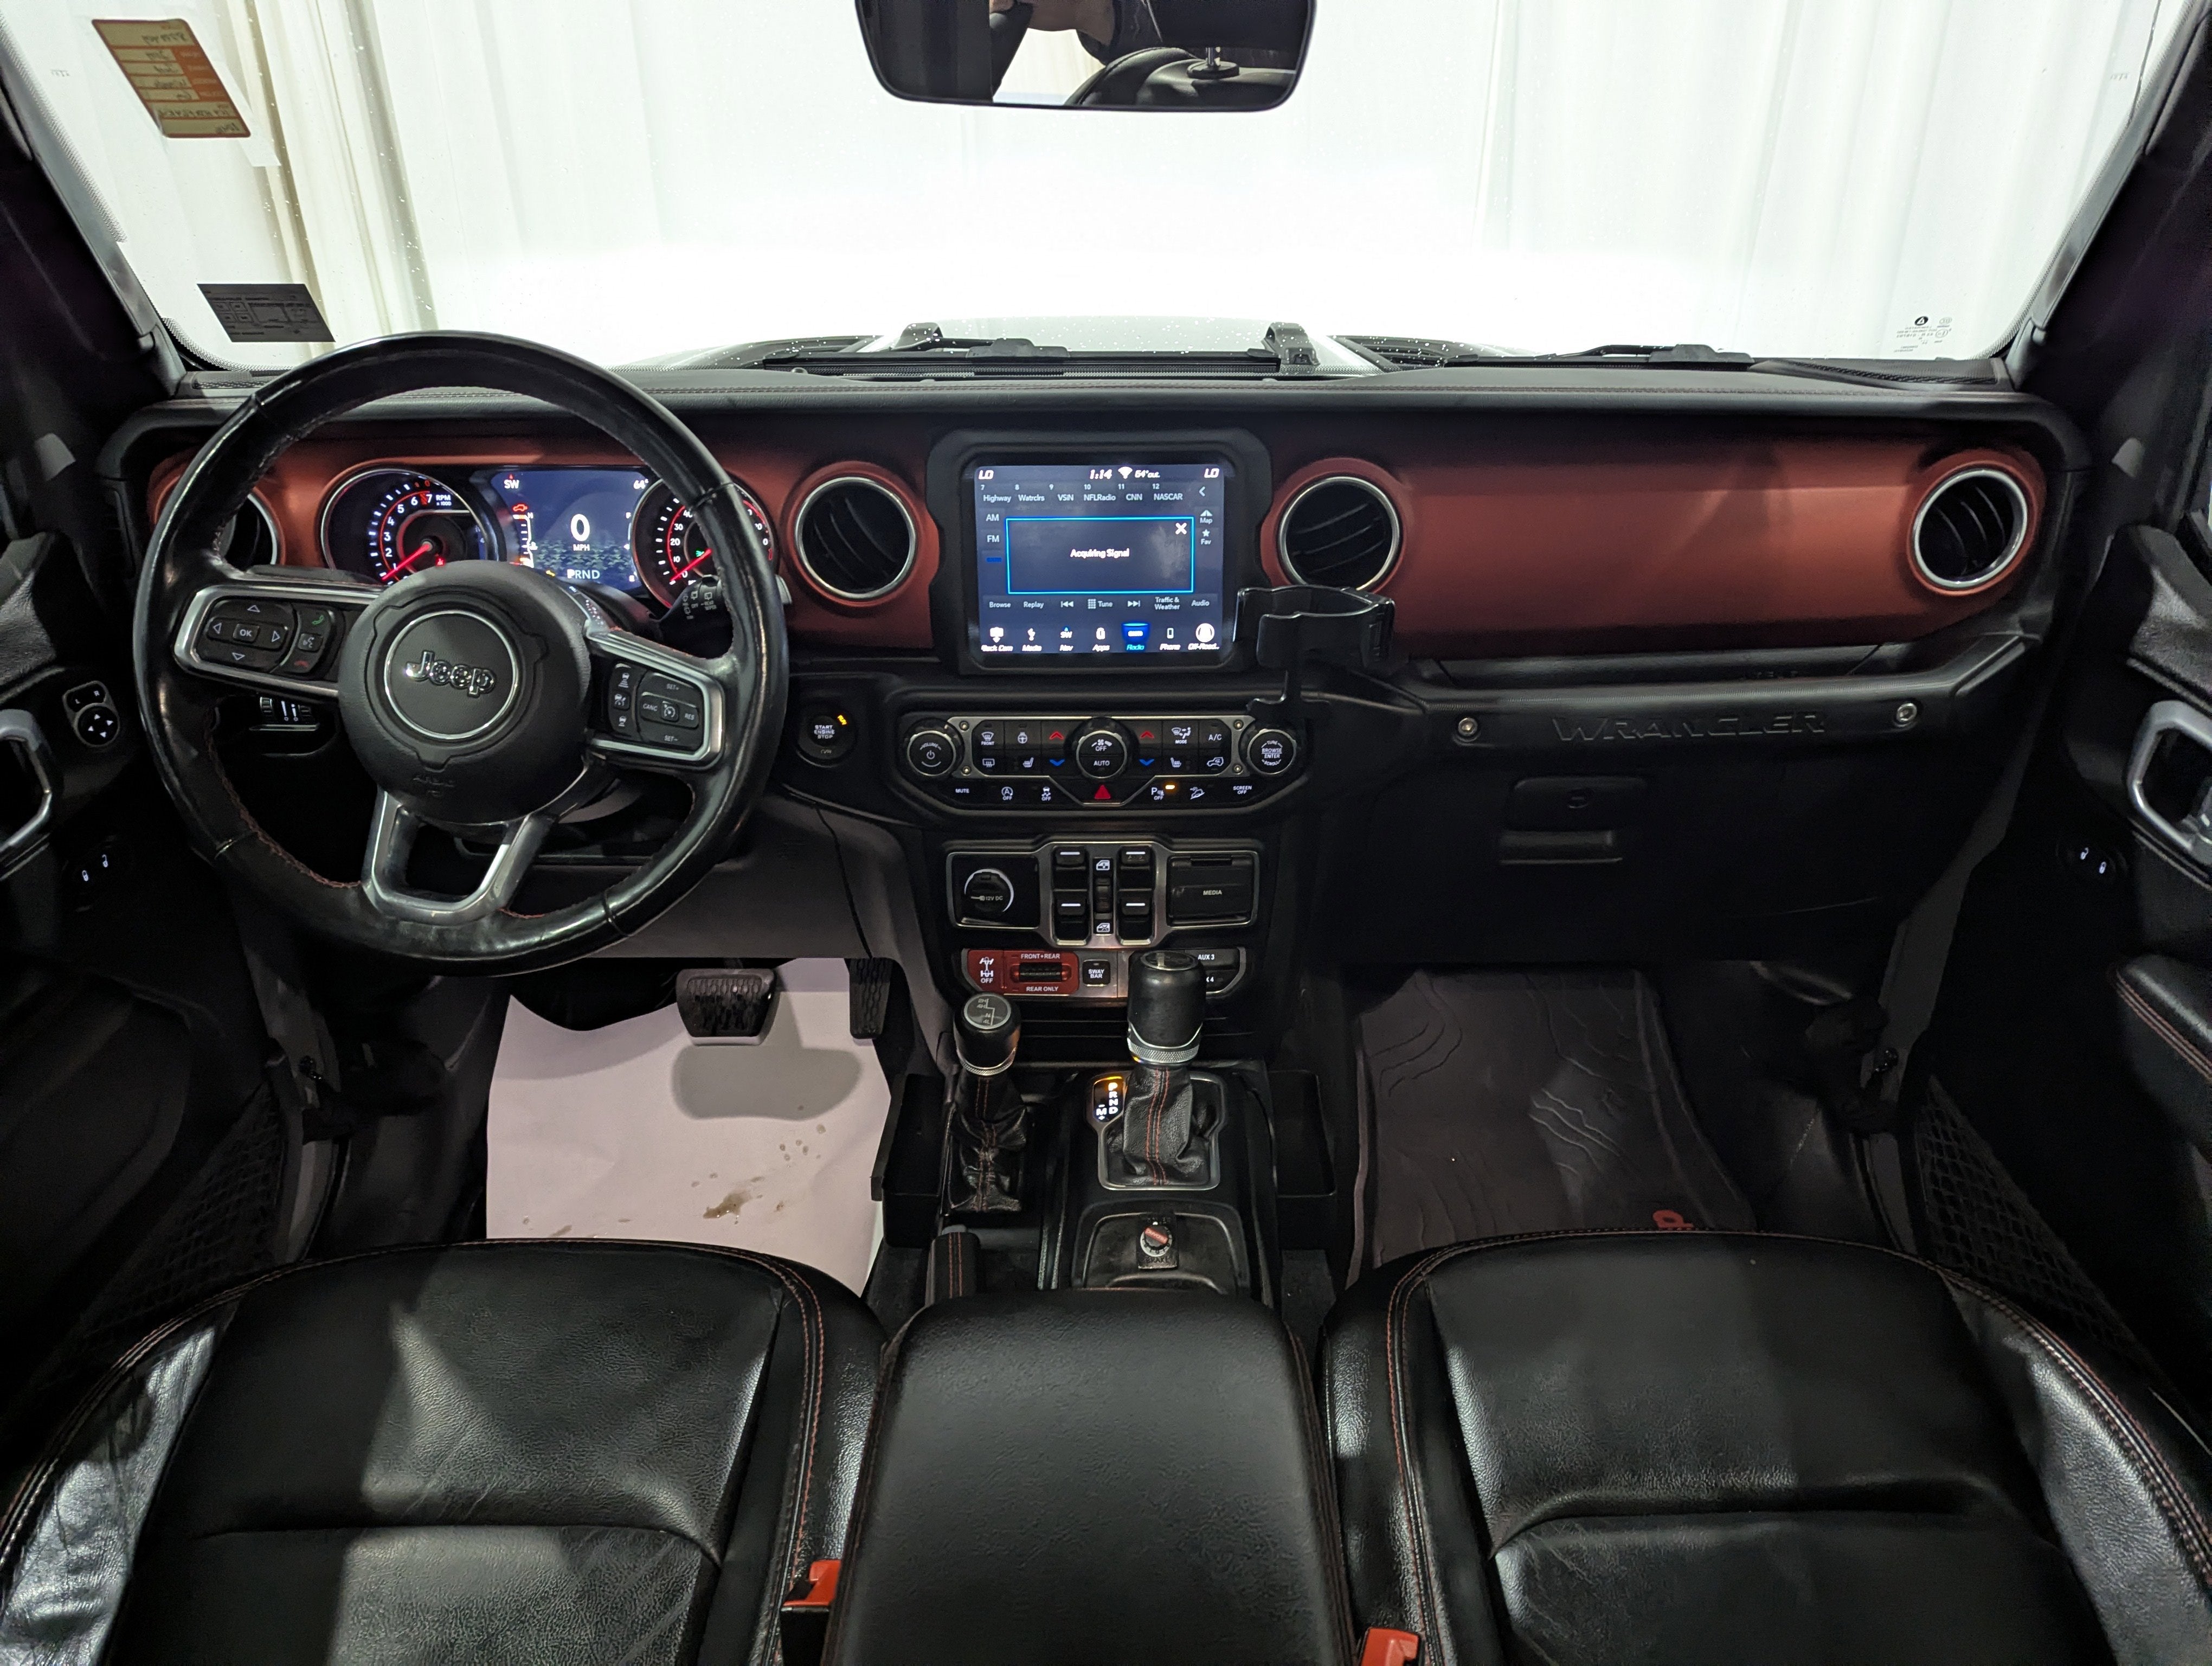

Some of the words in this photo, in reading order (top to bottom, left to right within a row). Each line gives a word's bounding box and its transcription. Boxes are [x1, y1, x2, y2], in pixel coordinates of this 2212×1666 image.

[978, 470, 994, 479] LO
[1090, 469, 1112, 479] 1:14
[1204, 468, 1219, 478] LO
[504, 479, 519, 489] SW
[411, 497, 417, 505] 6
[426, 494, 432, 503] 7
[983, 494, 1012, 503] Highway
[397, 504, 404, 513] 5
[388, 516, 395, 526] 4
[571, 514, 590, 541] 0
[384, 532, 390, 541] 3
[385, 548, 392, 557] 2
[1070, 549, 1106, 559] Acquiring
[1106, 548, 1129, 559] Signal
[406, 650, 496, 697] Jeep
[1108, 1082, 1118, 1091] P
[1109, 1098, 1118, 1106] N
[1096, 1107, 1107, 1116] M
[1109, 1106, 1118, 1114] D
